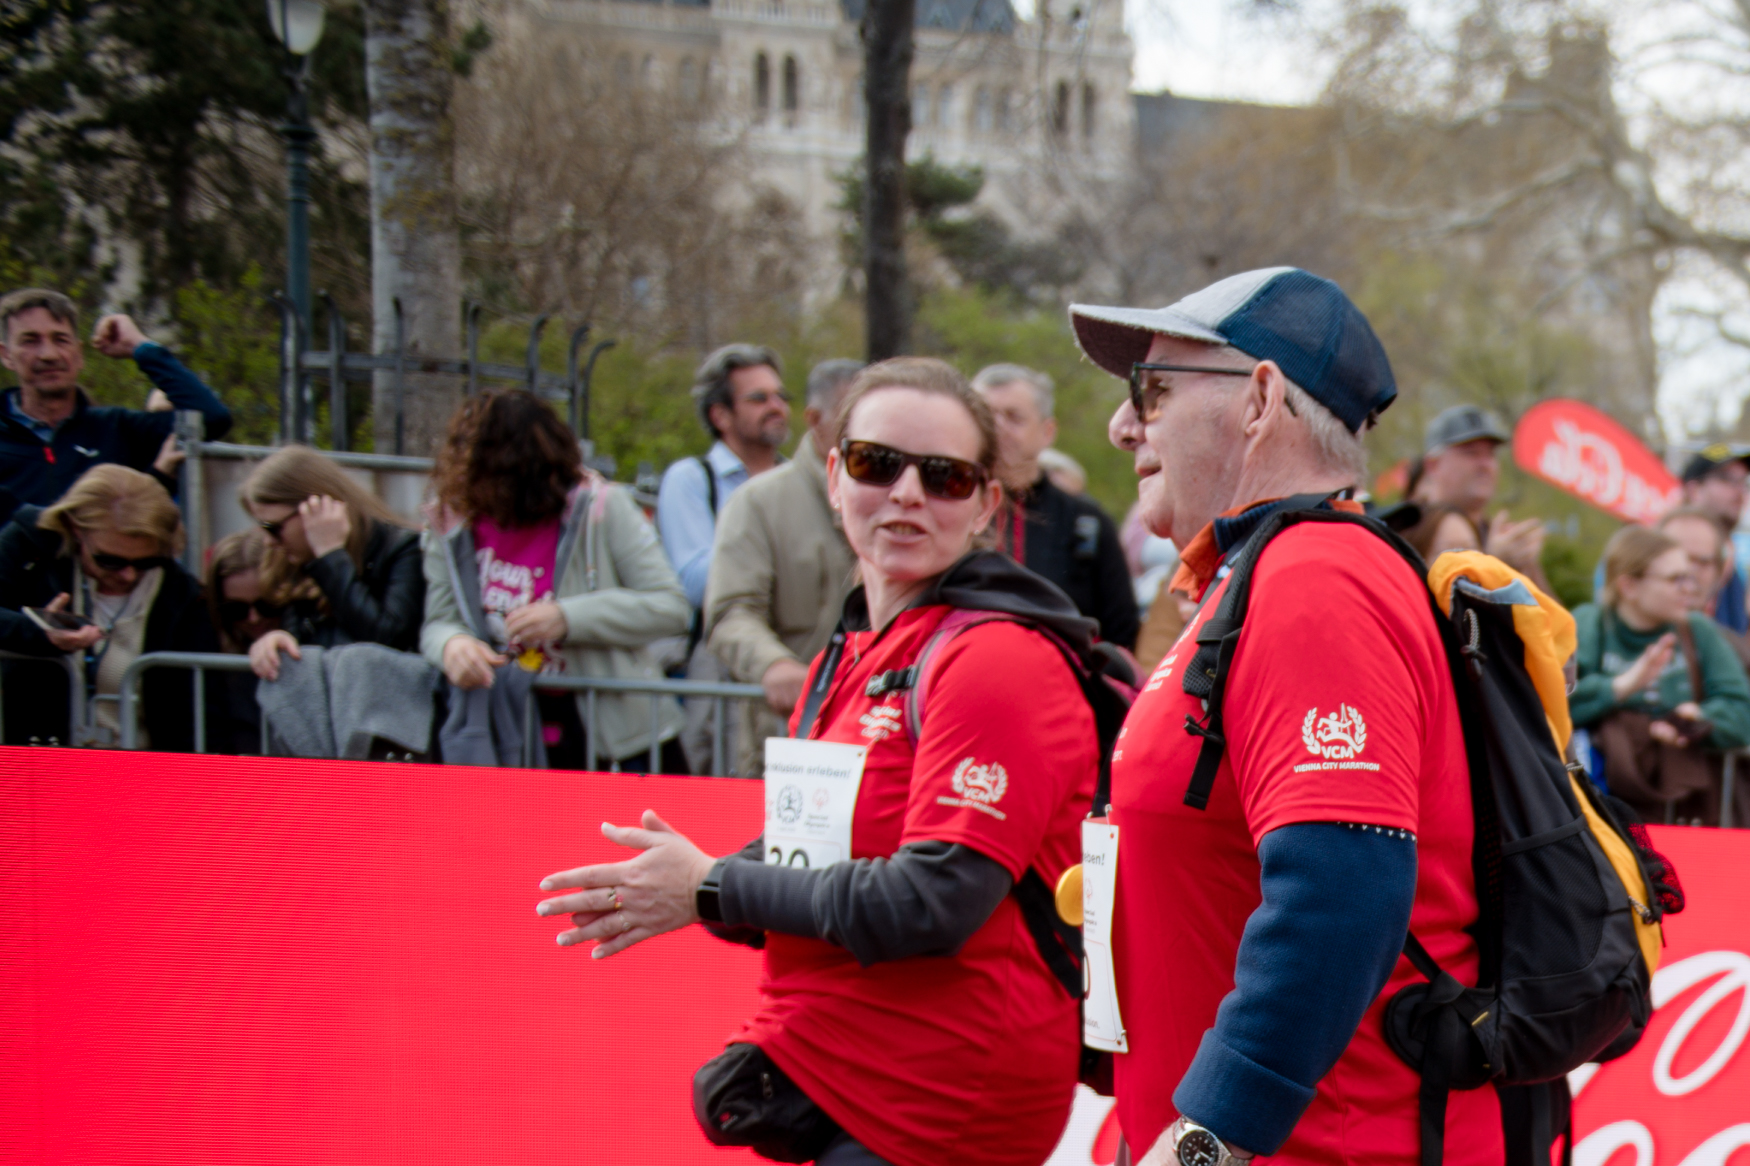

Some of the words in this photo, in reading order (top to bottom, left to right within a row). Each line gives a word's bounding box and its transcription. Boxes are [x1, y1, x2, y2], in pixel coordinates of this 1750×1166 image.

[1321, 745, 1354, 759] VCM
[1293, 763, 1321, 773] VIENNA
[1322, 762, 1338, 770] CITY
[1339, 762, 1380, 772] MARATHON
